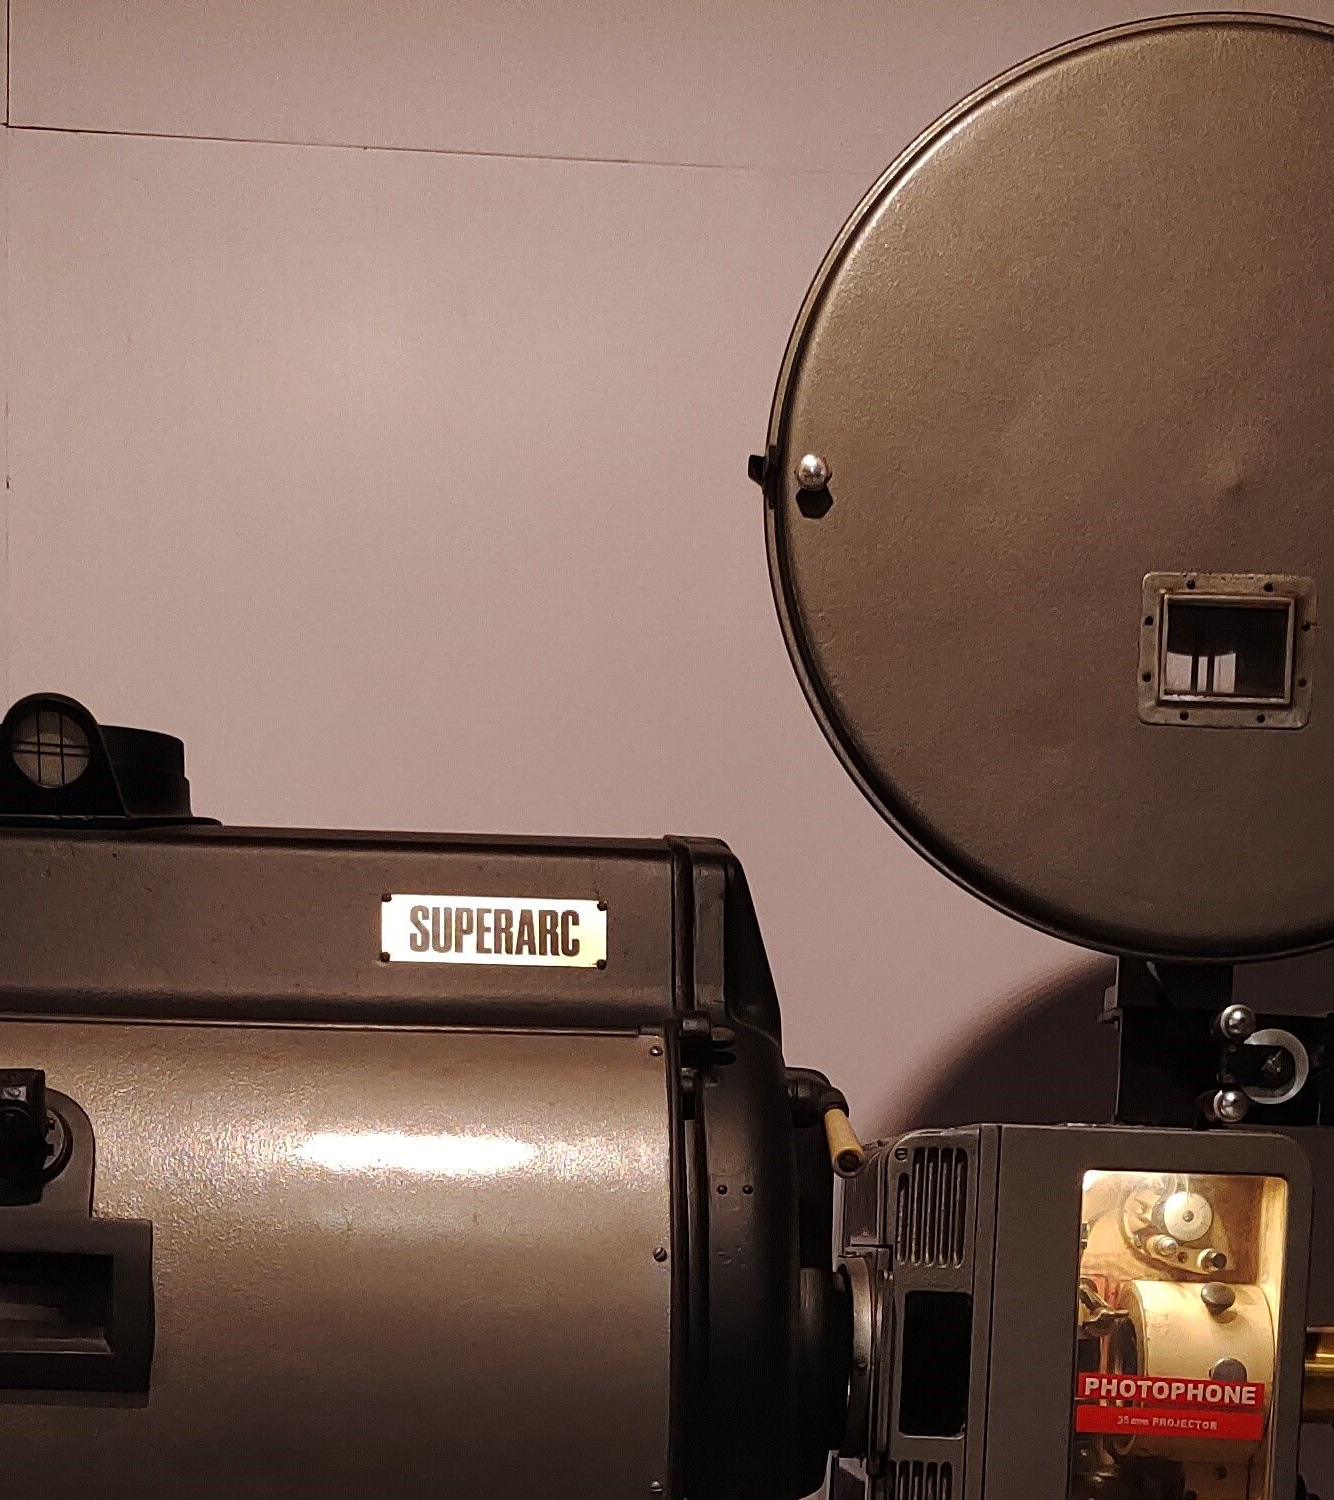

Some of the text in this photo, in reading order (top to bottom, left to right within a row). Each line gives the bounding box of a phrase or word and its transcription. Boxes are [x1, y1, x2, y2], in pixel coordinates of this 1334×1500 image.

[410, 905, 580, 957] SUPERARC
[1084, 1378, 1257, 1405] PHOTOPHONE
[1152, 1417, 1217, 1430] PROJECTOR
